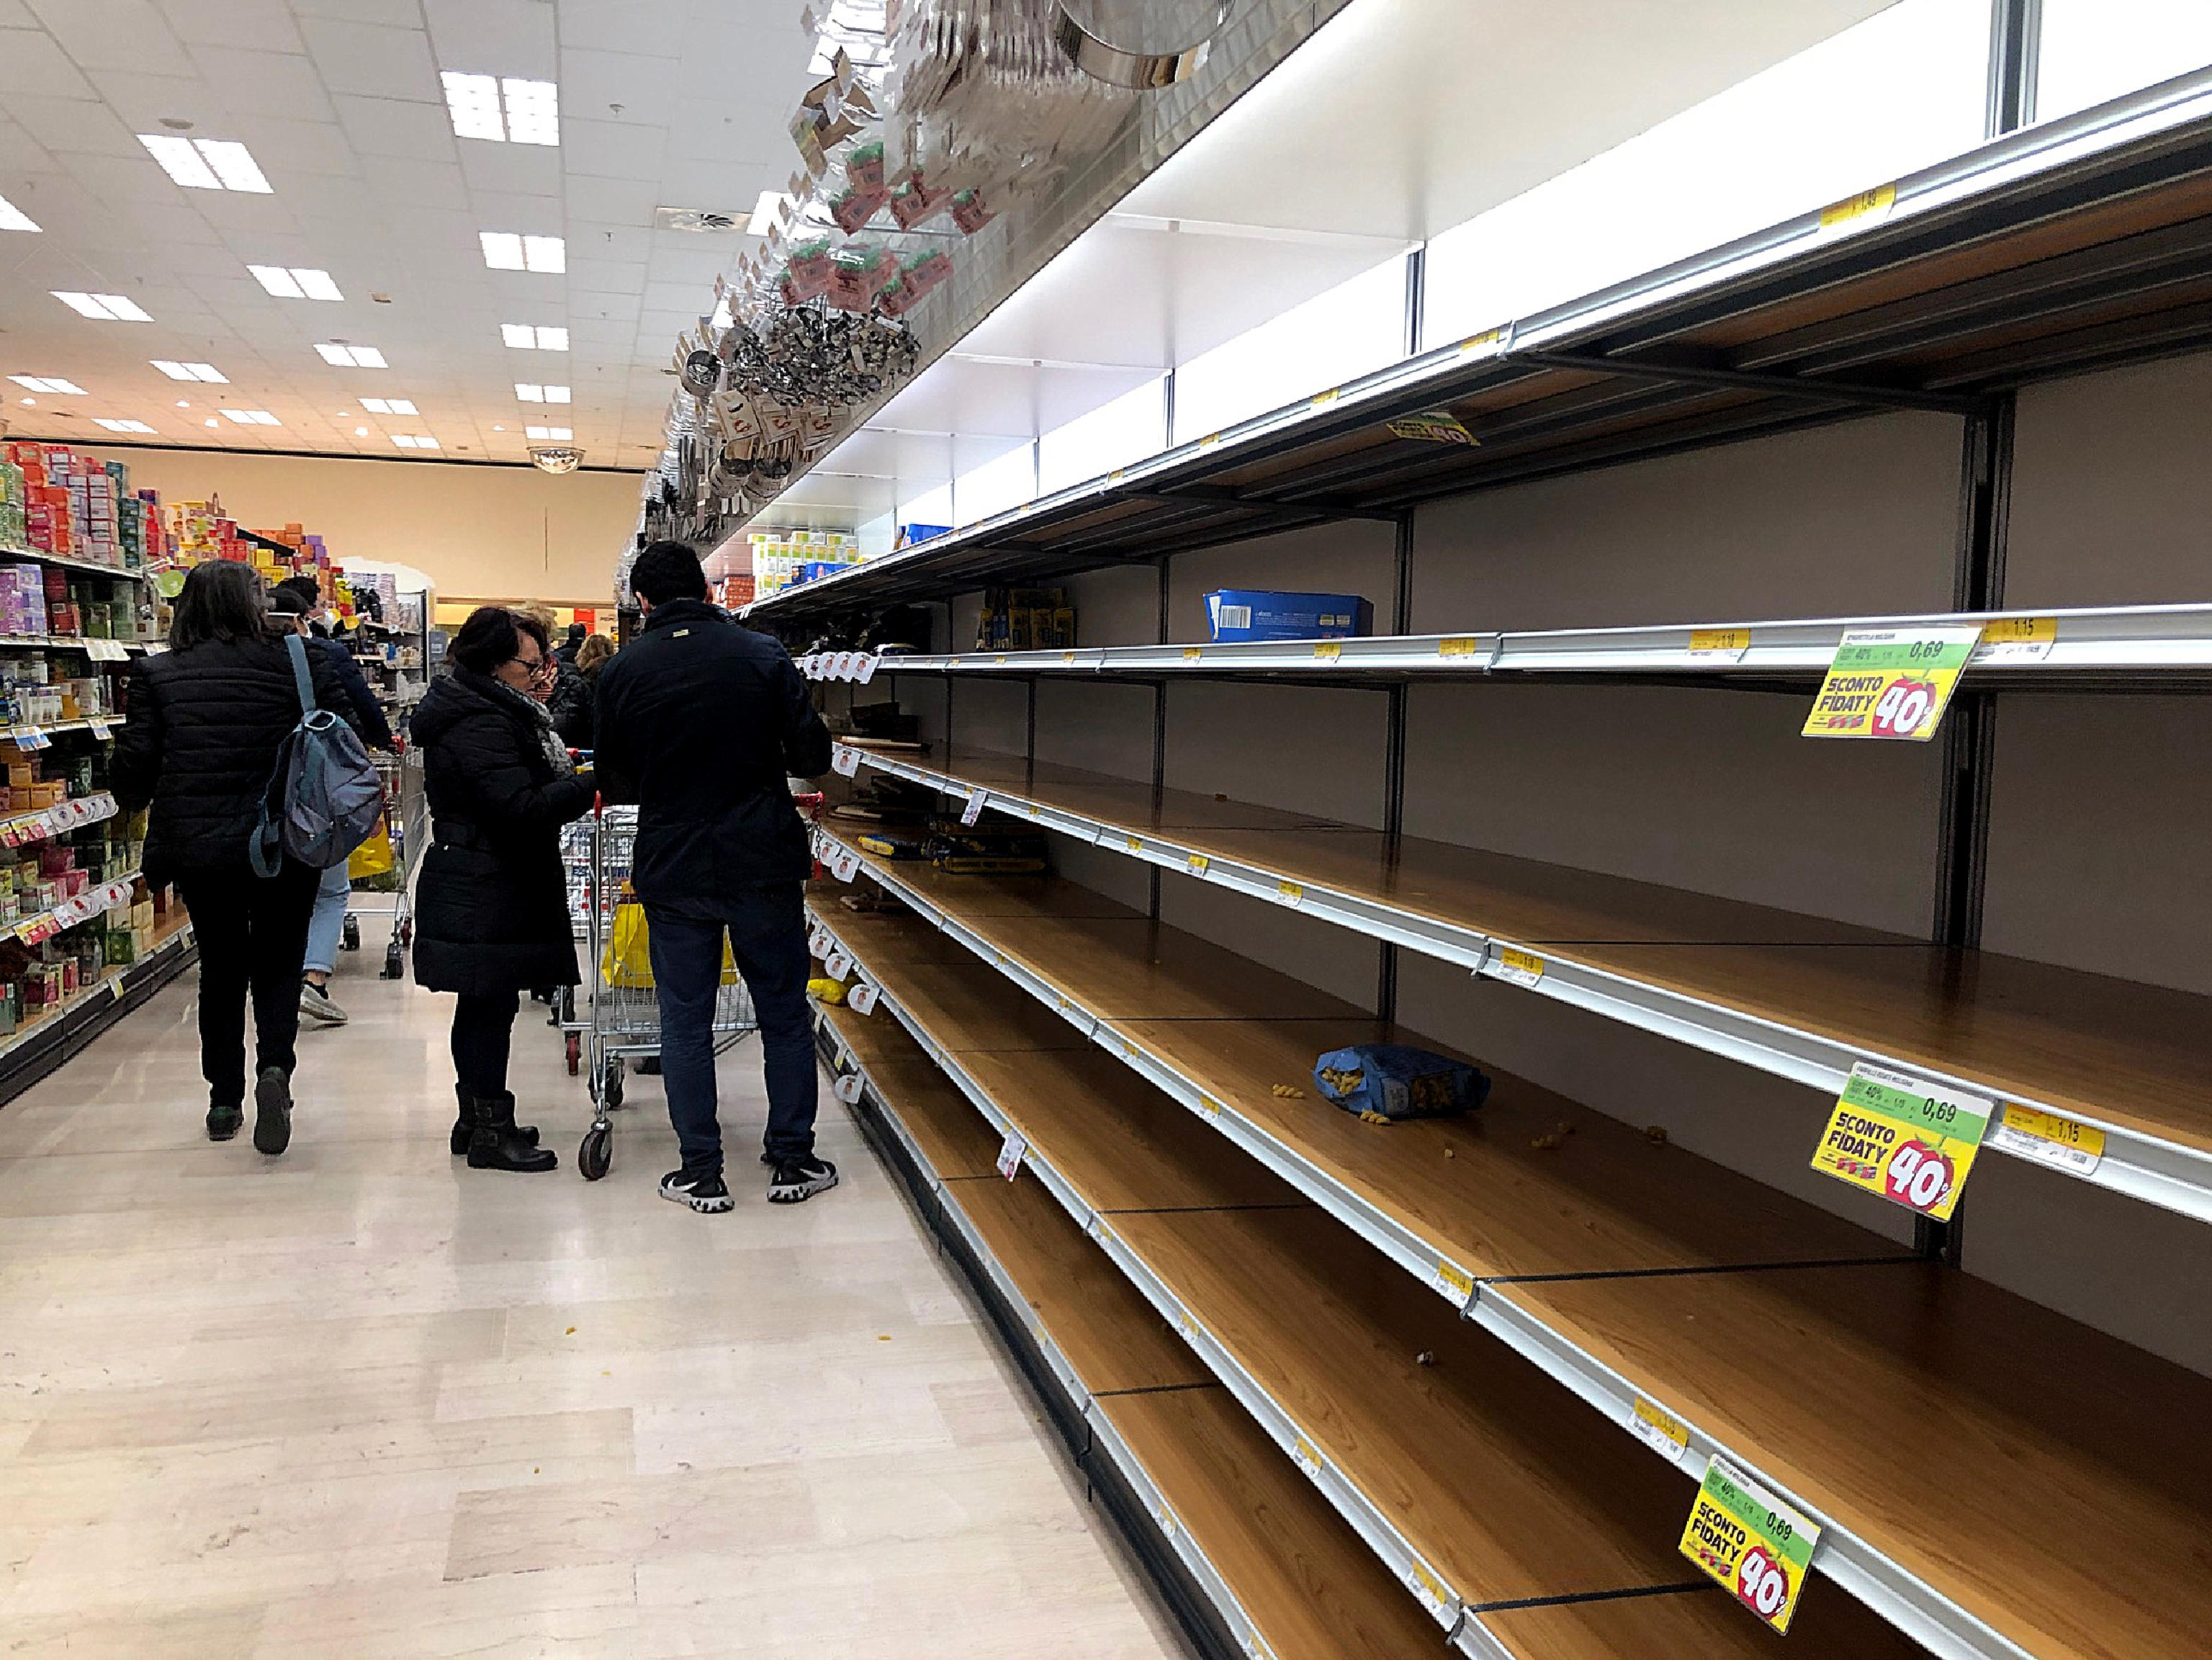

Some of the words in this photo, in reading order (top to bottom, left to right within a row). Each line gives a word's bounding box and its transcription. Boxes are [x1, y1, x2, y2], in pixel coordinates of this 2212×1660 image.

[1910, 640, 1944, 663] 0,69
[1827, 676, 1884, 692] SCONTO
[1817, 695, 1876, 712] FIDATY
[1876, 686, 1933, 733] 40%
[1923, 1098, 1956, 1122] 0,69
[1836, 1111, 1896, 1144] SCONTO
[2059, 1121, 2080, 1142] 1,15
[1827, 1130, 1889, 1163] FIDATY
[1889, 1146, 1954, 1206] 40%
[1691, 1517, 1741, 1562] FIDATY
[1698, 1502, 1746, 1545] SCONTO
[1766, 1512, 1792, 1541] 0,69
[1741, 1552, 1789, 1618] 40%
